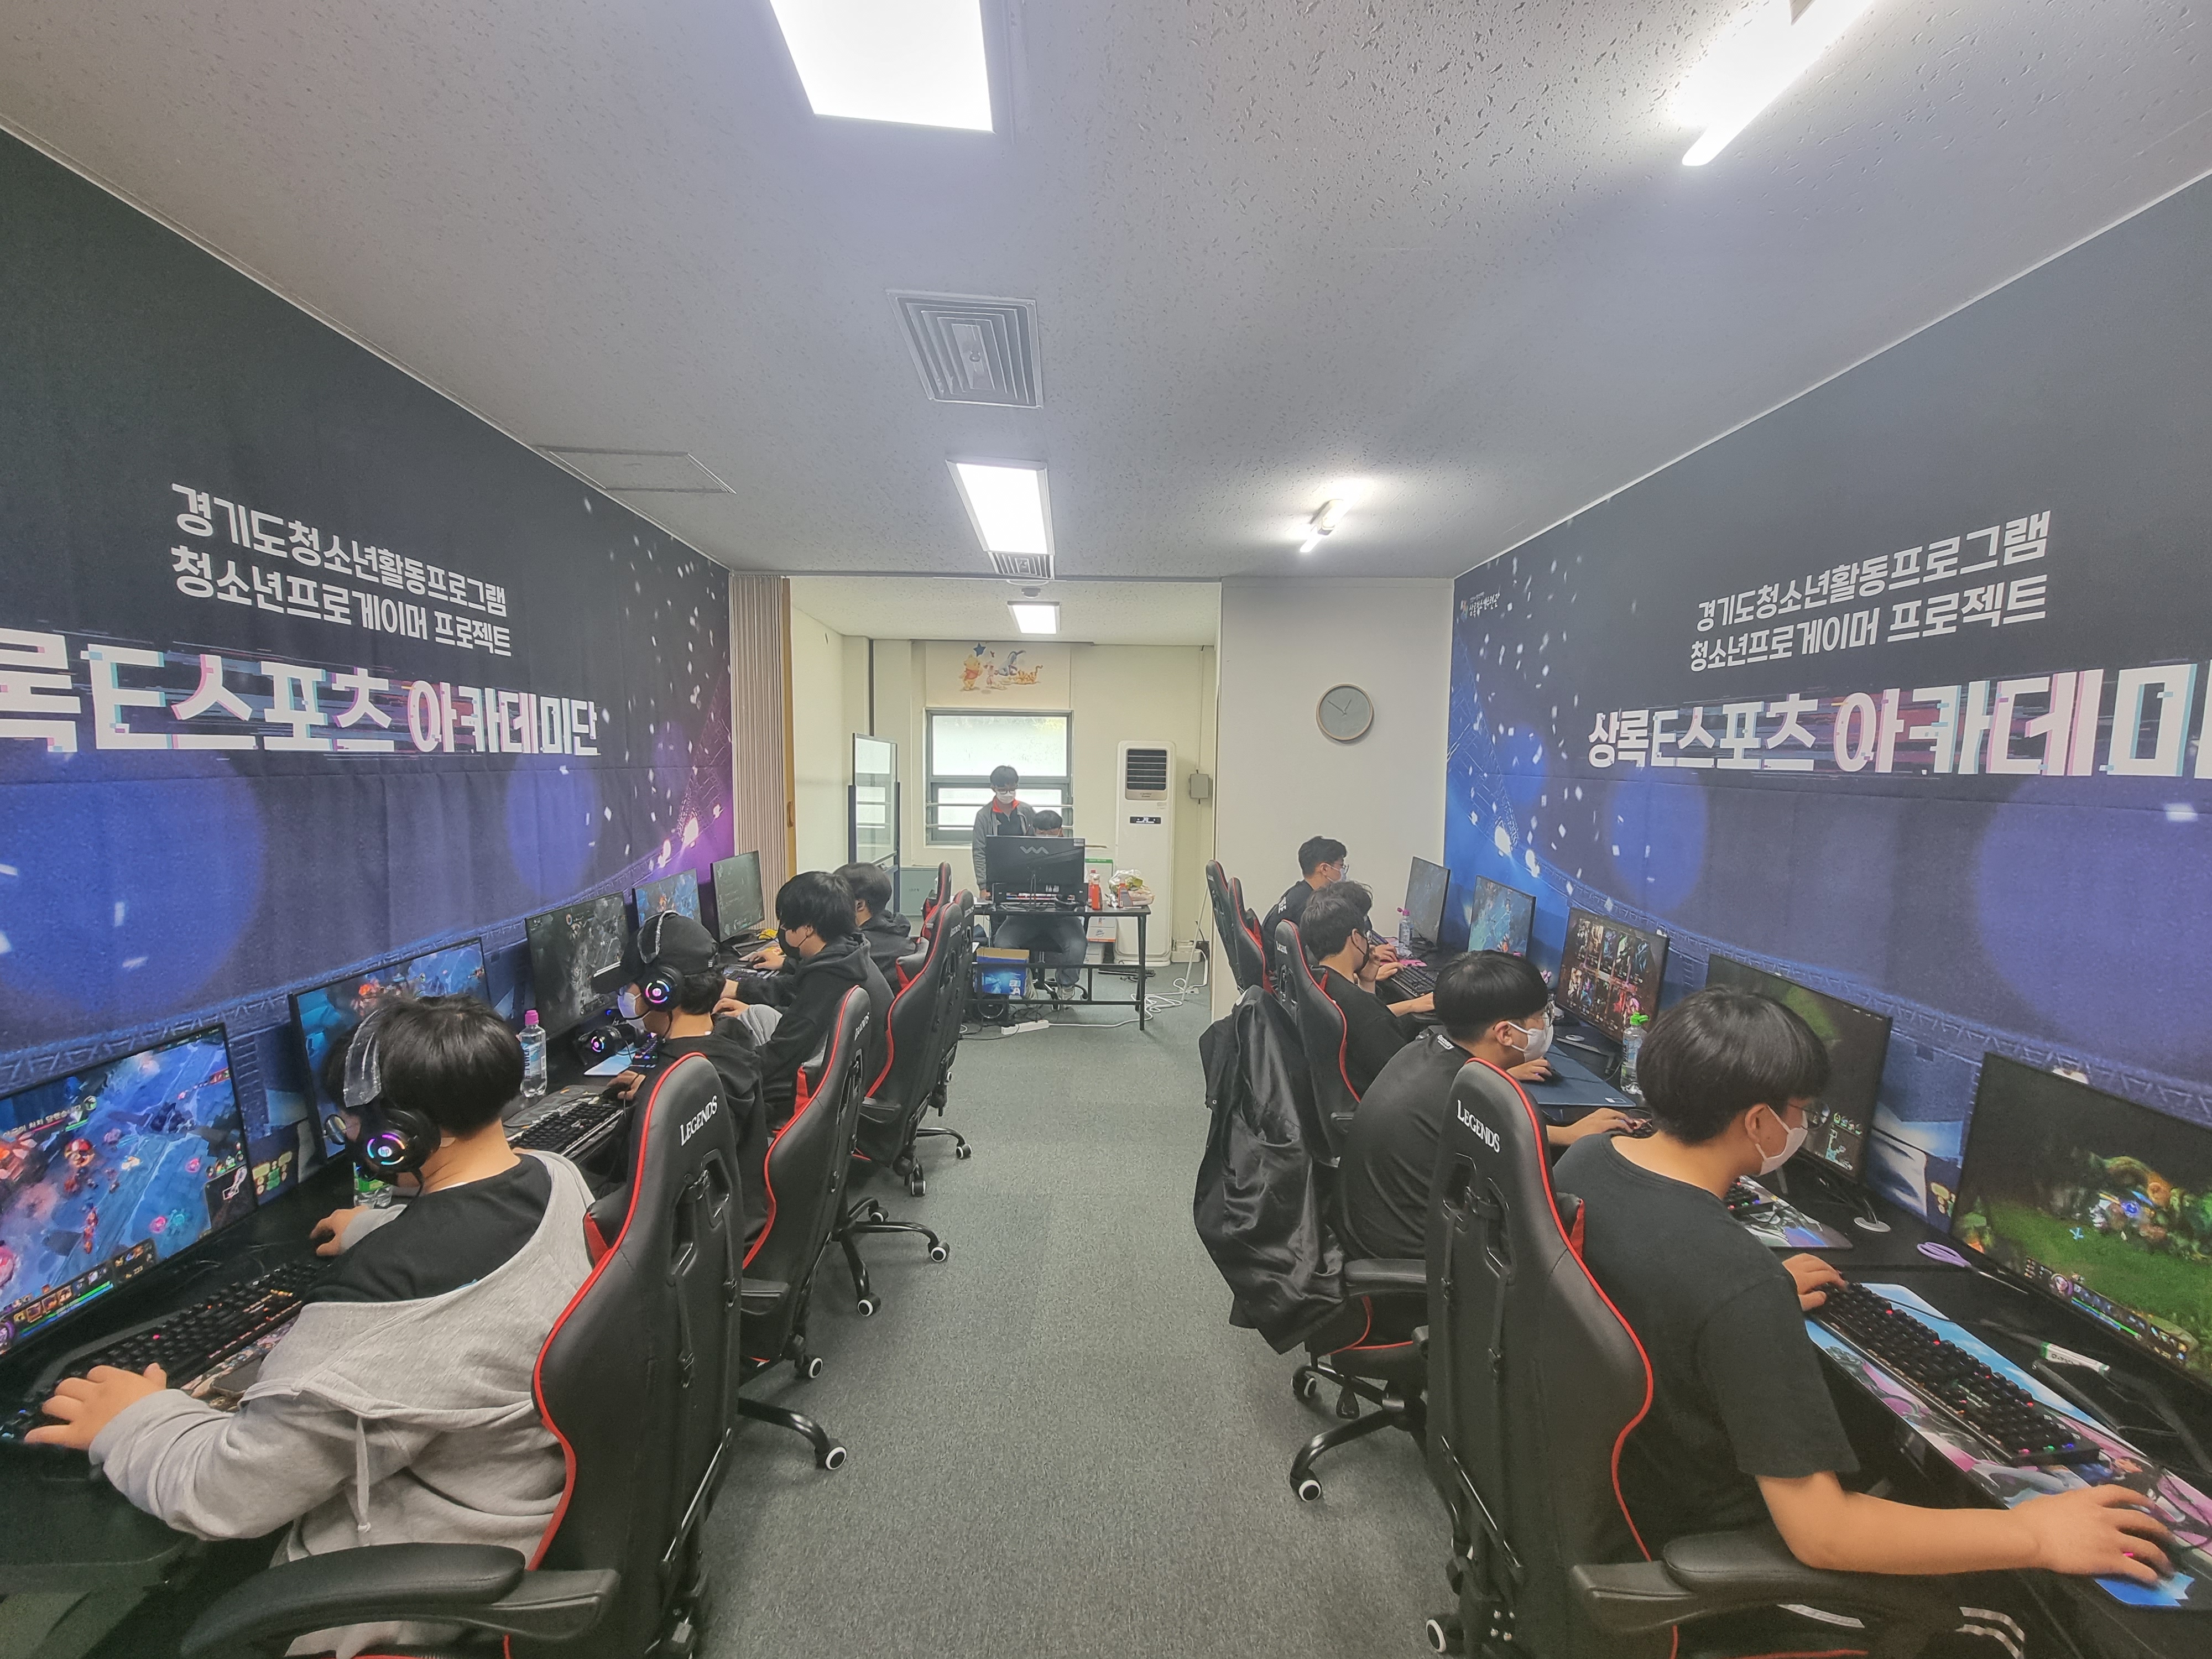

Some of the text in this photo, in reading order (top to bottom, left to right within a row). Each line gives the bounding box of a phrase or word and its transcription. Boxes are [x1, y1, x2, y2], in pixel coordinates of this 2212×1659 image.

[171, 483, 507, 618] 경기도청소년활동프로그램
[1695, 510, 2051, 632] 경기도청소년활동프로그램
[171, 545, 512, 657] 청소년프로게이머 프로젝트
[1690, 574, 2048, 672] 청소년프로게이머 프로젝트
[408, 680, 599, 756] 아카데미단
[1587, 692, 1819, 771] 상록E스포츠
[680, 1095, 718, 1146] LEGENDS
[1457, 1099, 1500, 1153] LEGENDS
